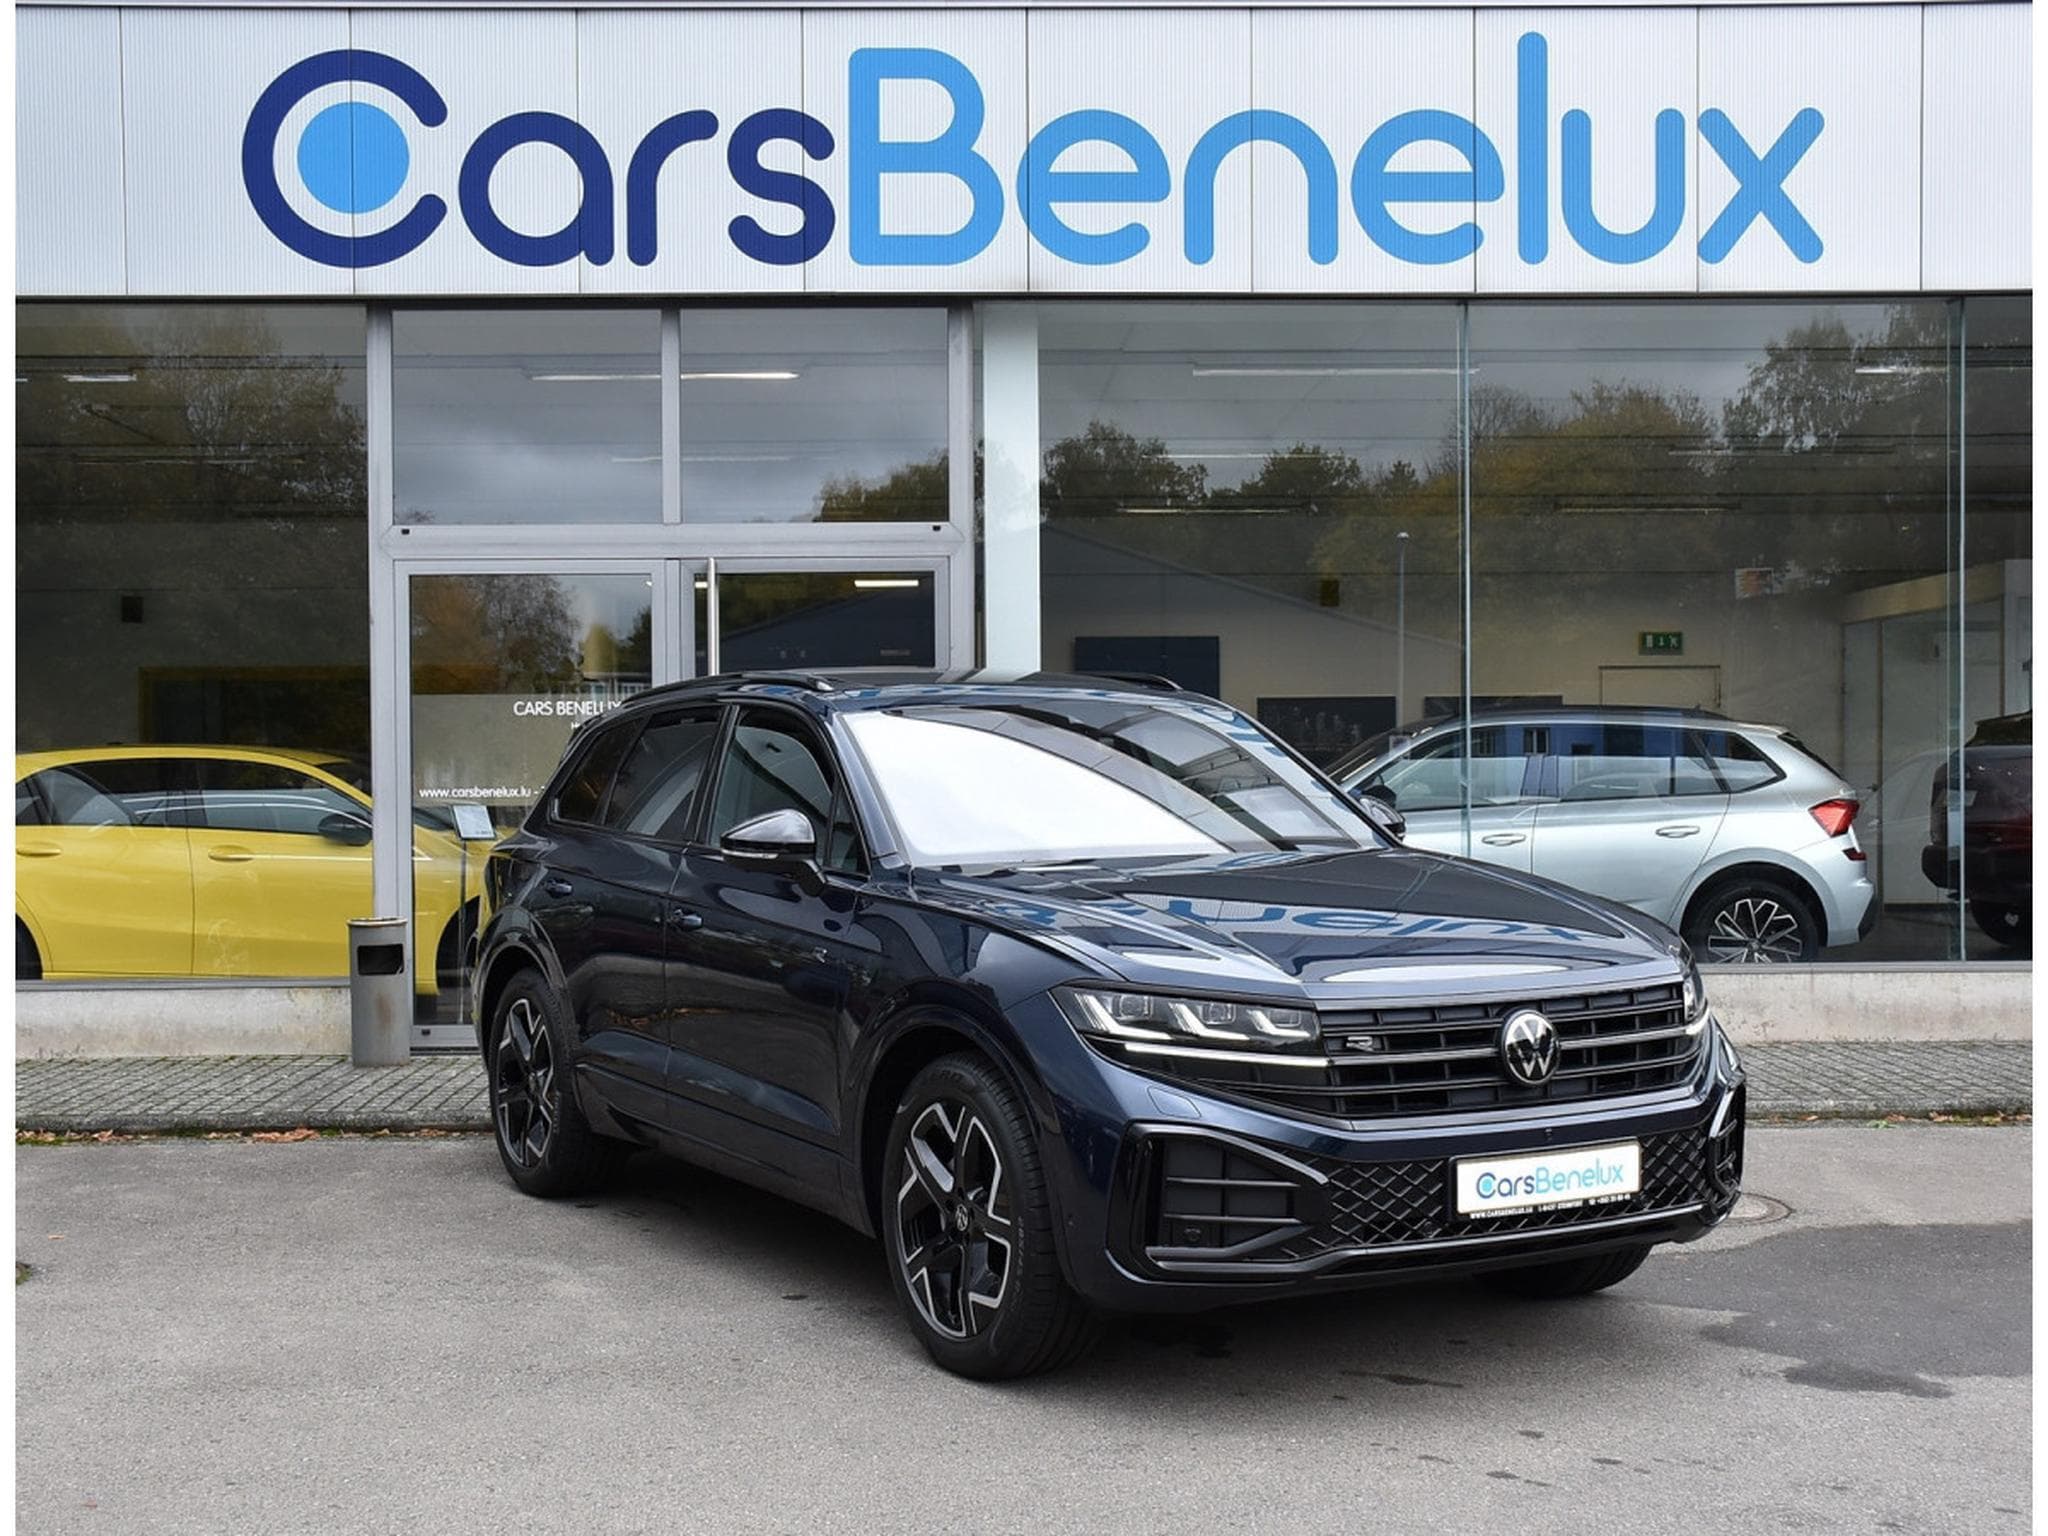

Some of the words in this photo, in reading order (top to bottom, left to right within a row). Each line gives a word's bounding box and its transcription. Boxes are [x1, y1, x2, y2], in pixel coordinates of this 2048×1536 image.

[243, 31, 1825, 268] CarsBenelux
[513, 701, 553, 716] CARS
[419, 786, 531, 798] www.carsbenelux.lu
[1476, 1157, 1624, 1199] CarsBenelux
